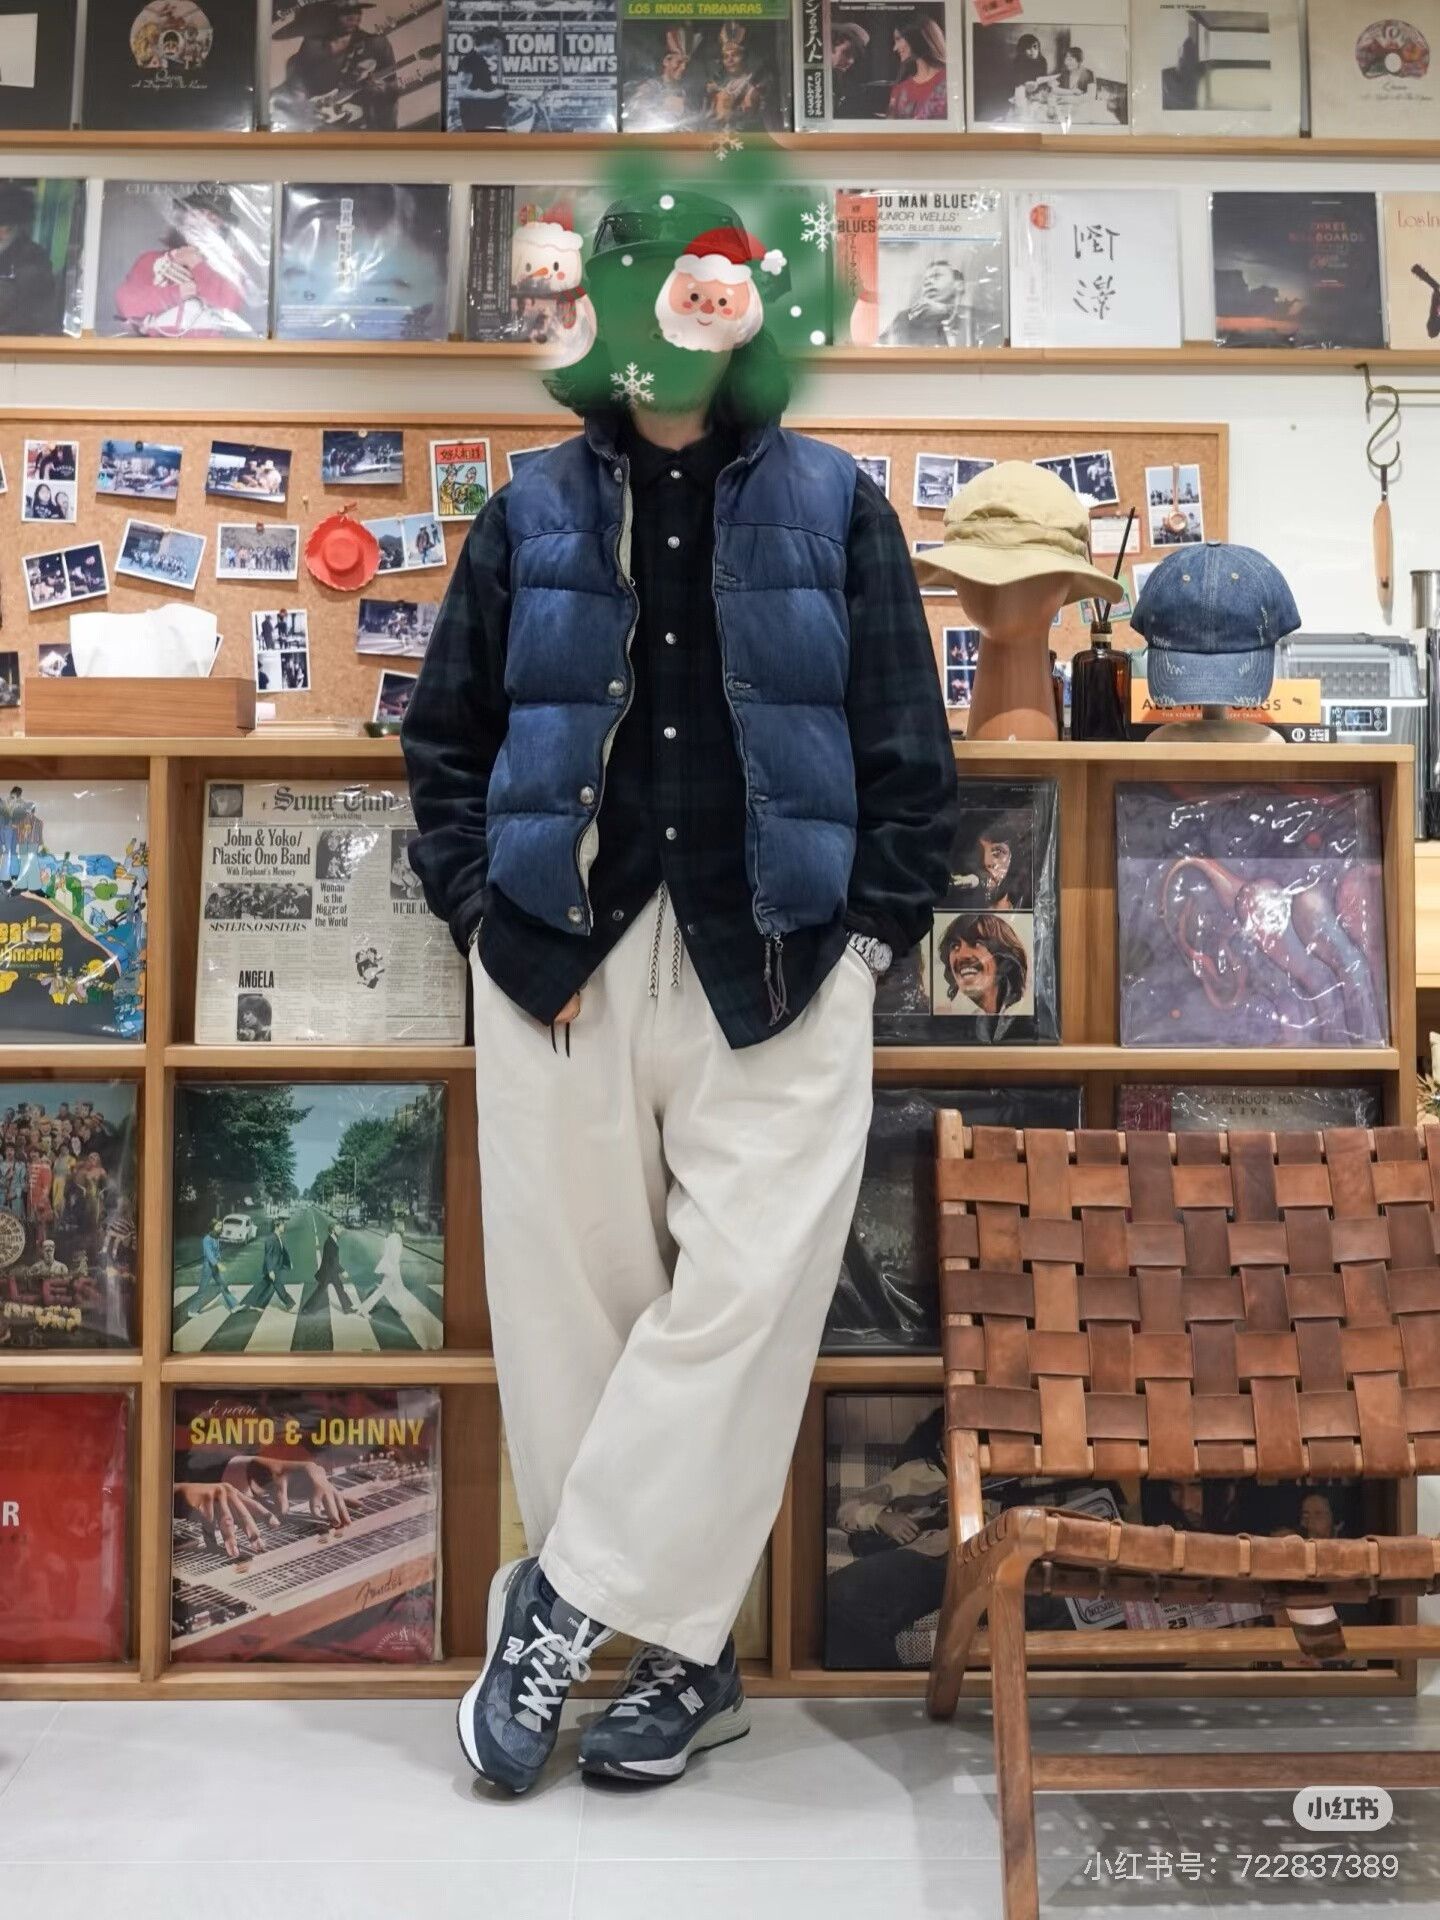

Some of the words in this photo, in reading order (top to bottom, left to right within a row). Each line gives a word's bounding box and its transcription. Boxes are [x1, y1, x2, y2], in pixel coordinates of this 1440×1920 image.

[628, 3, 650, 14] LOS
[655, 3, 694, 14] INDIOS
[698, 3, 763, 14] TABAJARAS
[448, 33, 474, 54] TO
[505, 33, 556, 54] TOM
[565, 33, 615, 54] TOM
[502, 55, 559, 73] WAITS
[562, 55, 617, 73] WAITS
[899, 193, 928, 208] MAN
[837, 219, 876, 233] BLUES
[908, 223, 935, 232] BLUES
[938, 223, 962, 232] BAND
[274, 786, 337, 811] Some
[224, 828, 252, 847] John
[254, 828, 265, 847] &
[268, 828, 303, 847] Yoko/
[212, 847, 252, 865] Plastic
[254, 847, 278, 865] Ono
[280, 846, 311, 865] Band
[226, 866, 240, 876] With
[272, 866, 296, 876] Memory
[320, 882, 345, 893] Woman
[323, 894, 330, 903] is
[331, 893, 343, 903] the
[340, 904, 348, 914] of
[264, 922, 307, 932] SISTERS
[315, 917, 326, 927] the
[328, 917, 348, 927] World
[238, 970, 274, 988] ANGELA
[0, 1275, 98, 1305] LES
[190, 1417, 275, 1446] SANTO
[285, 1418, 303, 1446] &
[311, 1418, 424, 1446] JOHNNY
[1168, 1607, 1188, 1619] 23
[677, 1685, 704, 1715] N
